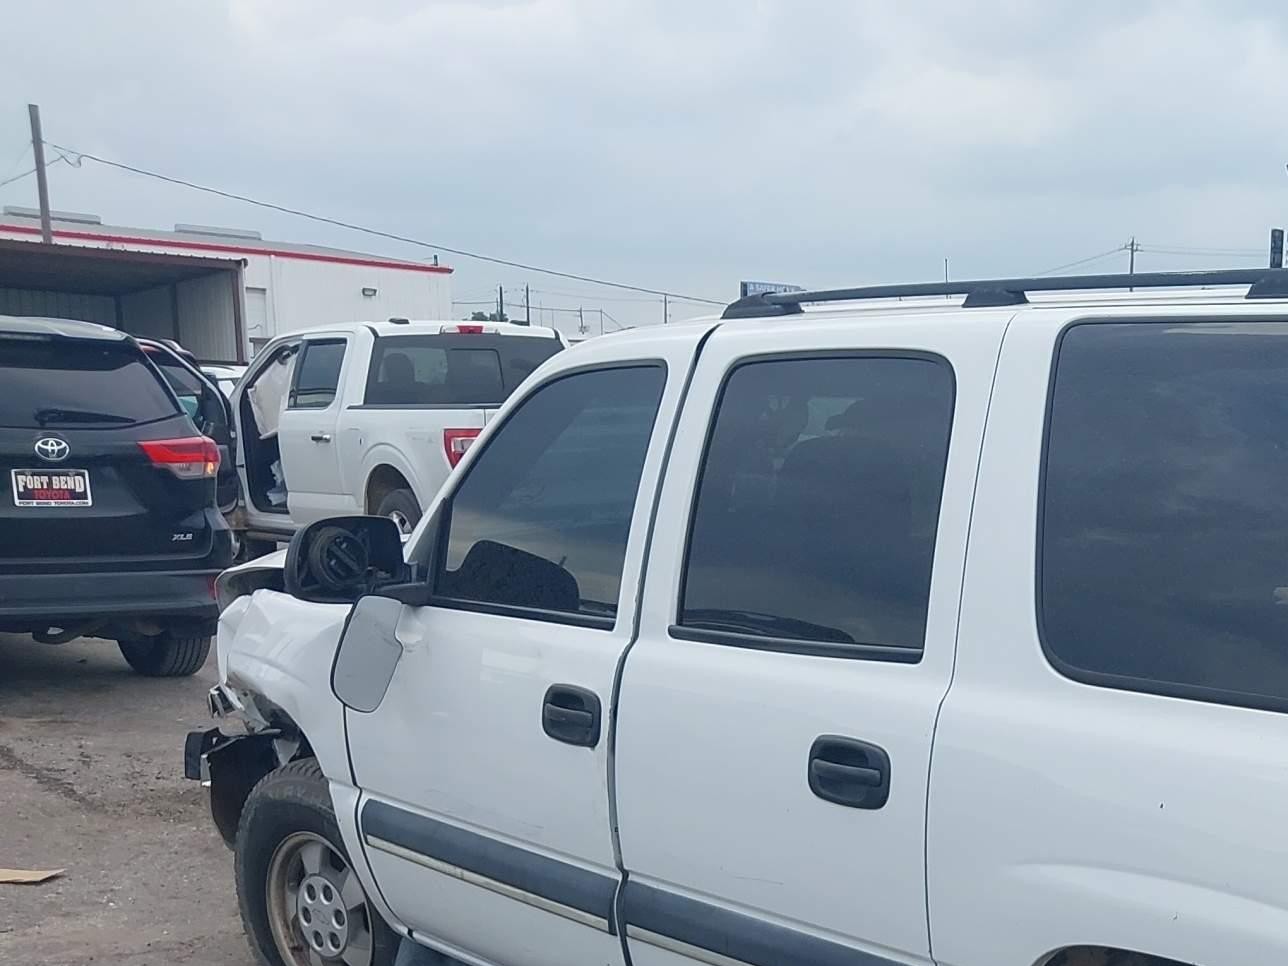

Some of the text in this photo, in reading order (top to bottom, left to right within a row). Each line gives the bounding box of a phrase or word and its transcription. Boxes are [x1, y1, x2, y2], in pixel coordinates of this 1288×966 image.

[17, 475, 85, 492] FORT BEND
[34, 490, 70, 499] TOYOTA
